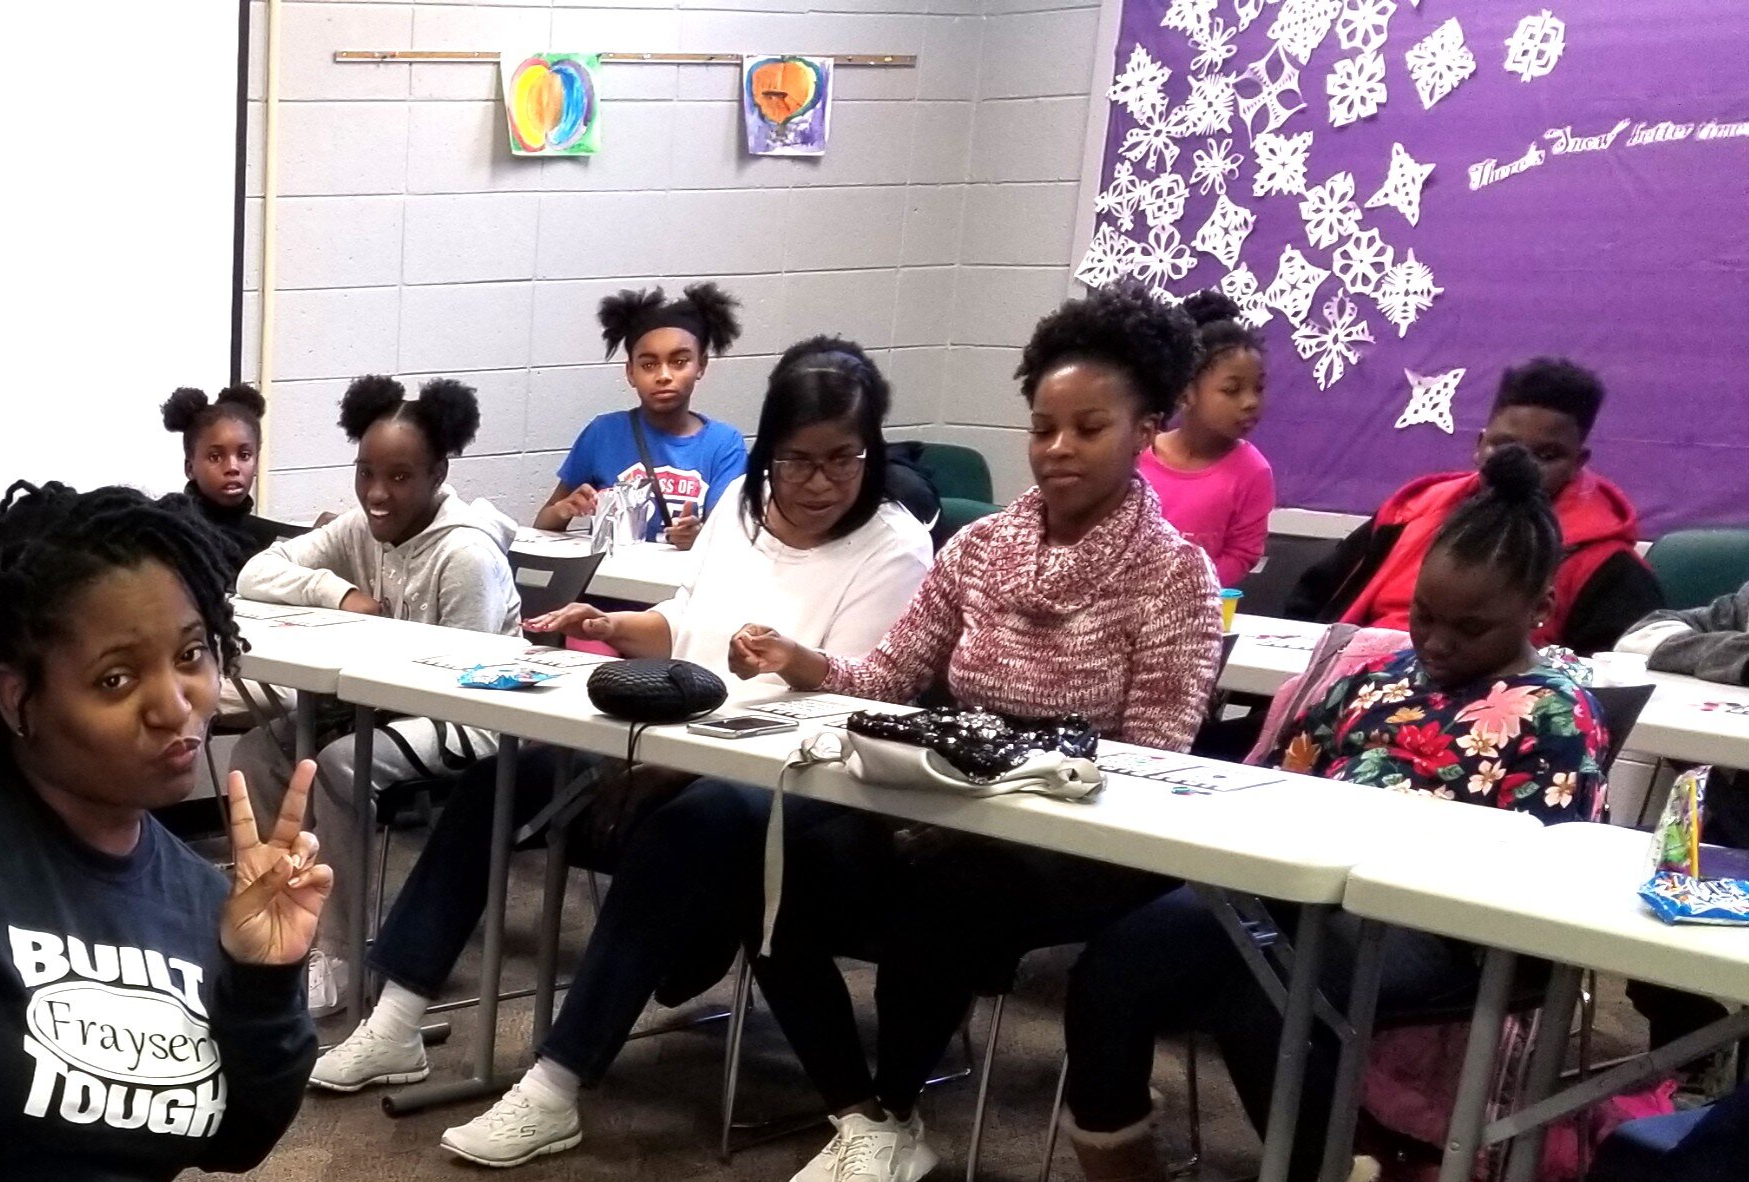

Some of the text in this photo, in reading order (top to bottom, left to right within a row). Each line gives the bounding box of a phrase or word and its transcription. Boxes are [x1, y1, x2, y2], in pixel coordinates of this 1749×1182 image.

[678, 480, 695, 495] OF
[8, 925, 210, 1019] BUILT
[44, 1000, 209, 1071] Frayser
[24, 1034, 228, 1138] TOUGH
